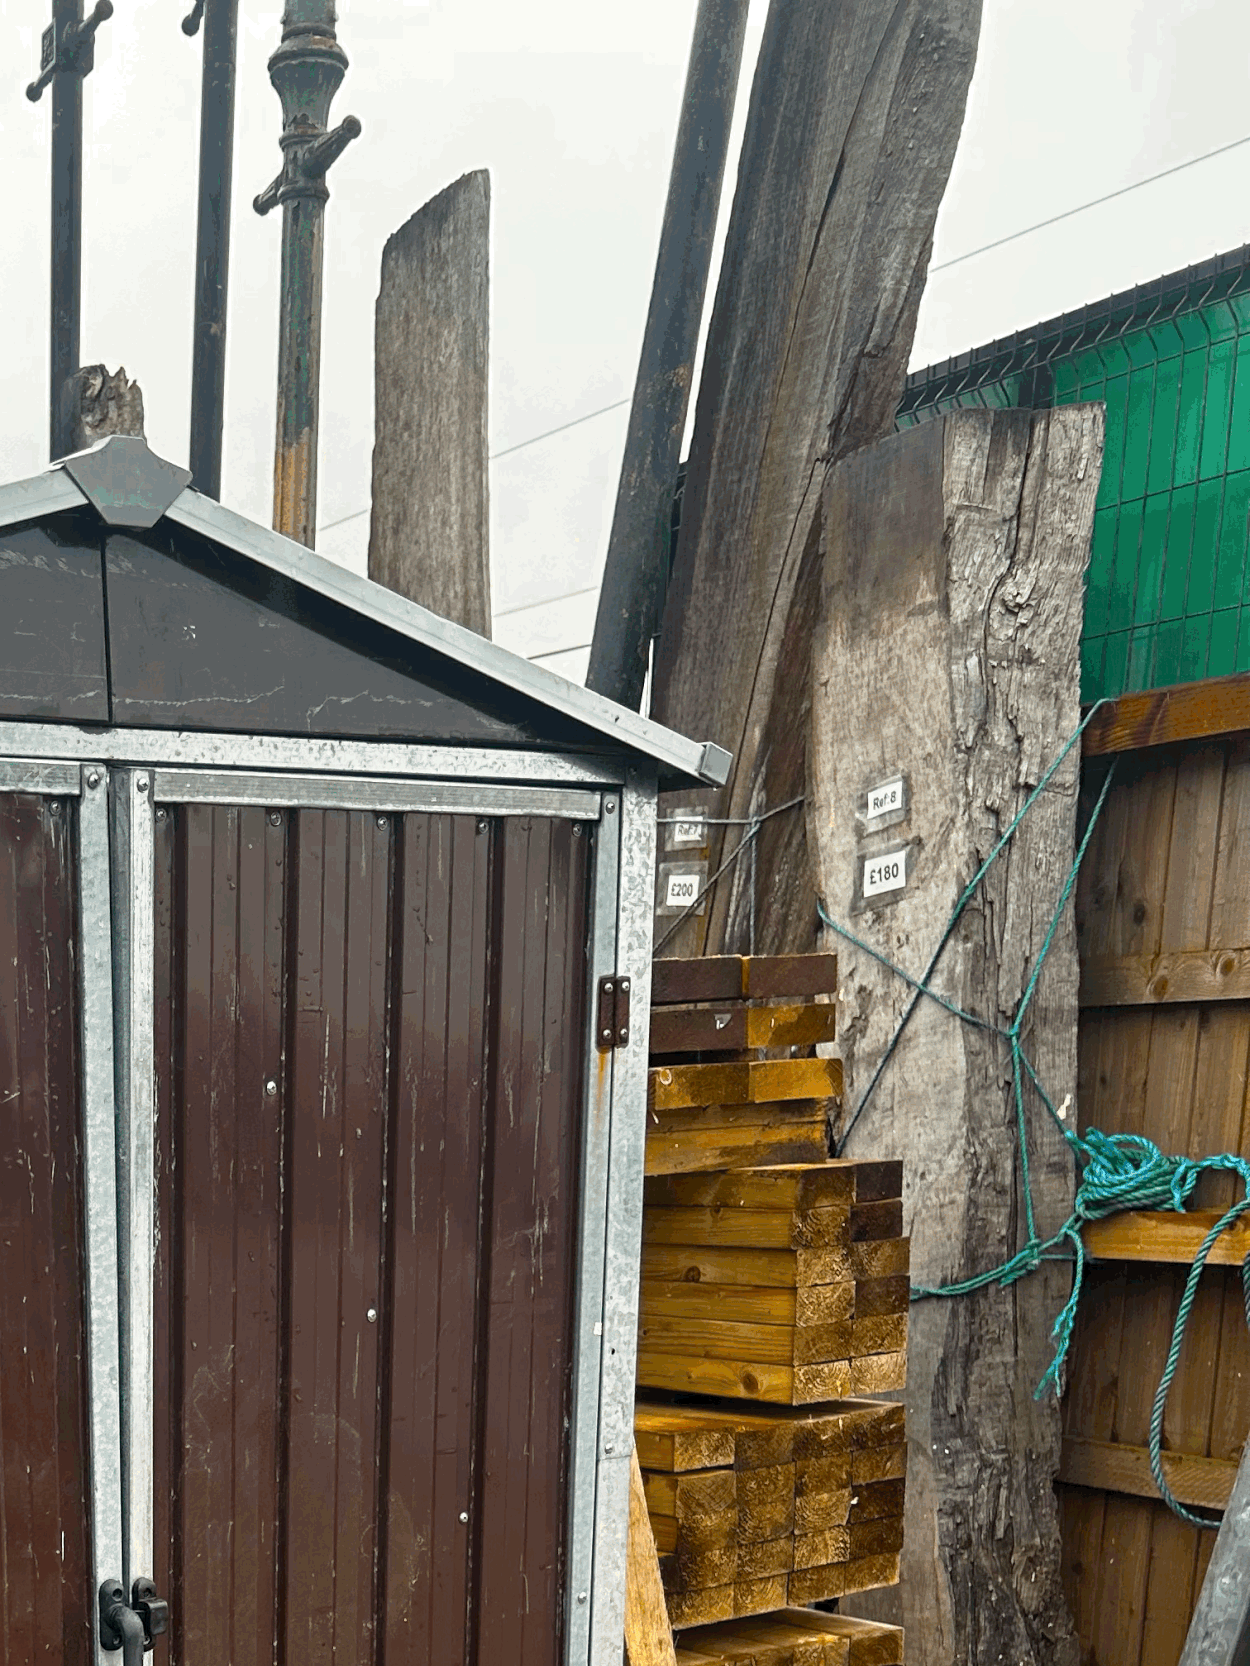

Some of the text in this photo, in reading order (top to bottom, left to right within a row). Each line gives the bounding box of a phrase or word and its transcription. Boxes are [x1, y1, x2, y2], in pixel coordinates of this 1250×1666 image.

[873, 791, 897, 810] Ref:8
[870, 862, 899, 885] £180
[670, 882, 694, 897] £200
